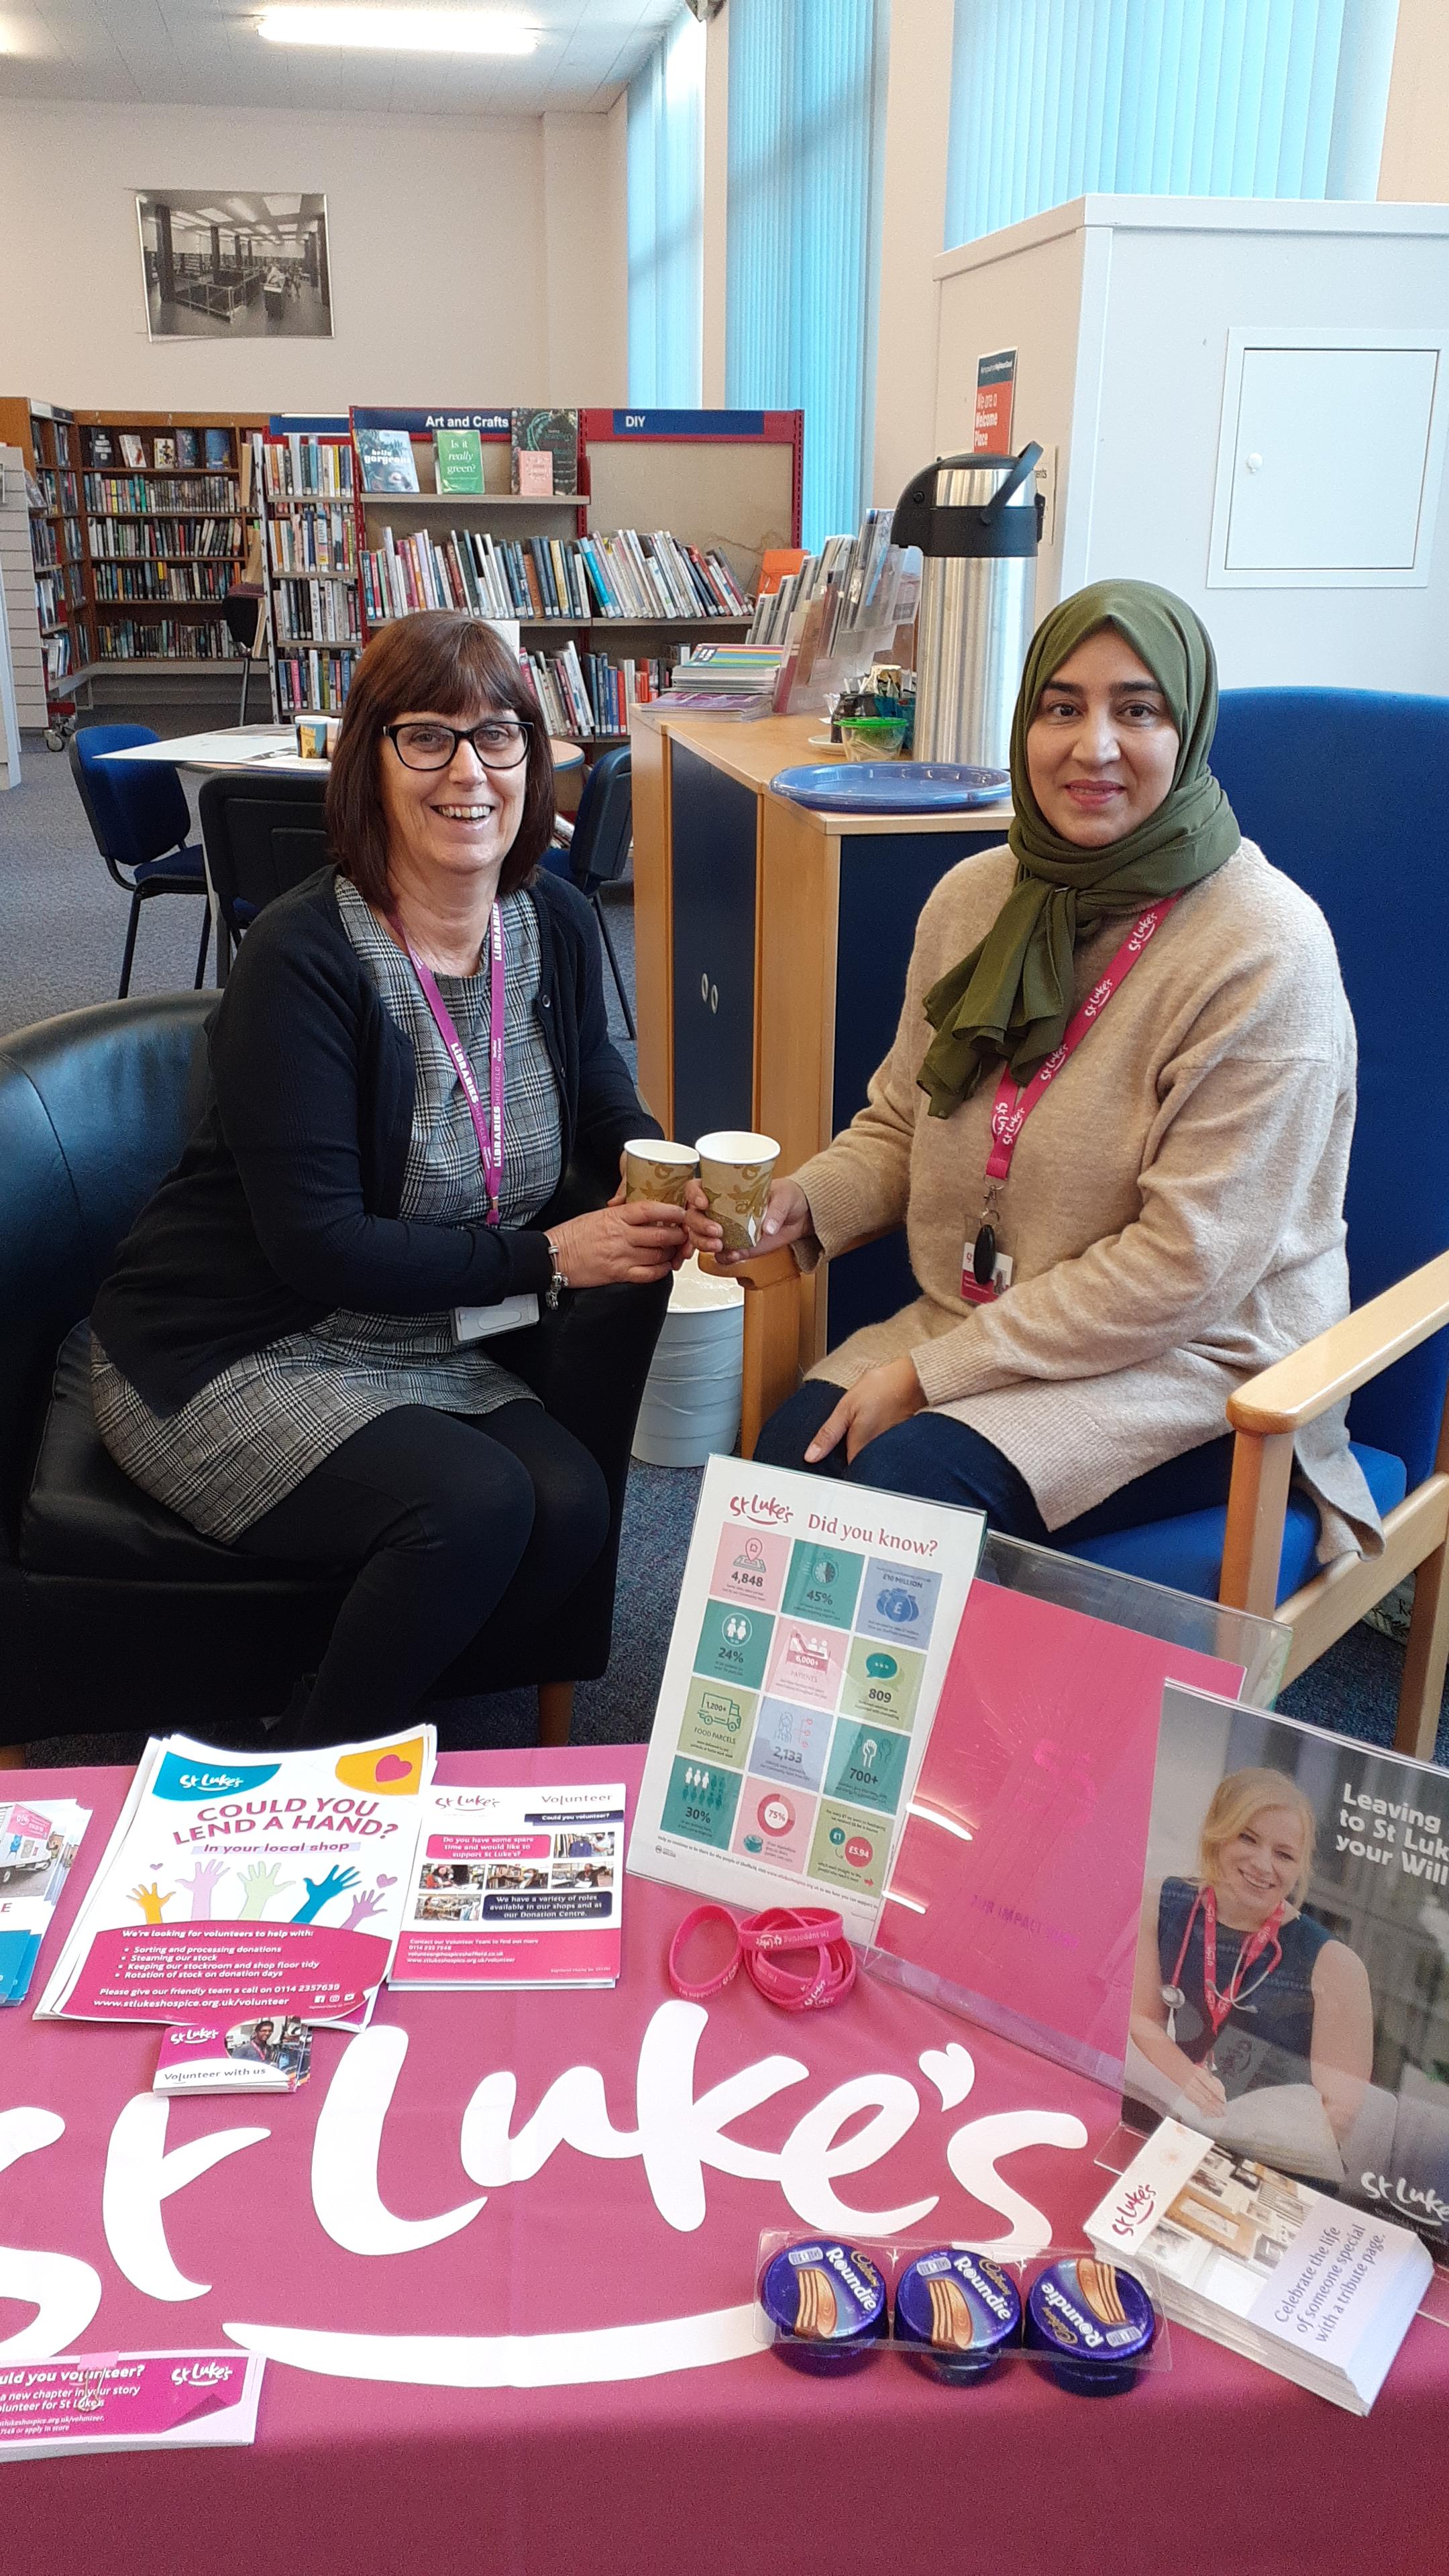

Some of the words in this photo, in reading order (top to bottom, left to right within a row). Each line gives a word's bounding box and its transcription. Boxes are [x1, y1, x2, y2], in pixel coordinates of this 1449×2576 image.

[425, 416, 444, 427] Art
[447, 416, 470, 427] and
[472, 416, 509, 427] Crafts
[625, 415, 645, 427] DIY
[976, 411, 998, 428] Welcome
[450, 440, 461, 448] Is
[462, 439, 468, 448] it
[975, 430, 988, 447] Place
[447, 451, 474, 463] really
[447, 464, 476, 475] green?
[1132, 913, 1157, 939] Luke's
[1128, 938, 1141, 951] St
[1089, 979, 1113, 1006] Luke's
[1084, 1004, 1097, 1016] St
[1045, 1044, 1069, 1069] Luke's
[1041, 1068, 1052, 1080] St
[474, 1104, 486, 1141] SHEFFIELD
[1002, 1132, 1012, 1144] St
[730, 1496, 750, 1516] St
[751, 1495, 794, 1523] Luke's
[808, 1513, 838, 1534] Did
[840, 1524, 873, 1543] you
[879, 1528, 938, 1557] know?
[731, 1571, 763, 1587] 4,848
[896, 1576, 923, 1589] MILLION
[806, 1590, 833, 1605] 45%
[718, 1648, 744, 1664] 24%
[796, 1654, 819, 1666] 6,000+
[868, 1688, 892, 1703] 809
[706, 1701, 727, 1712] 1,200+
[694, 1727, 712, 1739] FOOD
[712, 1731, 736, 1744] PARCELS
[773, 1746, 802, 1764] 2,133
[179, 1774, 199, 1788] St
[201, 1773, 244, 1788] Luke's
[849, 1768, 879, 1784] 700+
[197, 1798, 308, 1821] COULD
[316, 1798, 380, 1817] YOU
[435, 1797, 454, 1809] St
[541, 1794, 613, 1805] Volunteer
[1343, 1782, 1441, 1835] Leaving
[685, 1807, 711, 1824] 30%
[768, 1809, 786, 1822] 75%
[172, 1818, 256, 1845] LEND
[262, 1816, 284, 1830] A
[292, 1815, 399, 1839] HAND?
[1340, 1809, 1365, 1832] to
[1373, 1819, 1396, 1843] St
[833, 1832, 842, 1840] £1
[203, 1844, 221, 1852] In
[223, 1844, 260, 1854] your
[264, 1842, 305, 1852] local
[309, 1843, 350, 1854] shop
[1336, 1835, 1393, 1866] your
[1401, 1851, 1449, 1886] Will
[539, 1895, 566, 1903] variety
[151, 1930, 186, 1939] looking
[267, 1930, 288, 1939] help
[134, 1946, 167, 1955] Sorting
[186, 1946, 235, 1955] processing
[127, 1963, 164, 1971] Keeping
[253, 1962, 275, 1970] shop
[301, 1961, 320, 1969] tidy
[131, 1955, 173, 1963] Steaming
[218, 1970, 260, 1978] donation
[262, 1970, 283, 1978] days
[130, 1988, 150, 1996] give
[170, 1988, 206, 1996] friendly
[274, 1985, 297, 1993] 0114
[93, 1998, 290, 2008] www.stlukeshospice.org.uk/volunteer
[170, 2033, 185, 2045] St
[164, 2070, 221, 2082] Volunteer
[223, 2068, 250, 2076] with
[311, 2000, 1088, 2263] Luke's
[1360, 2171, 1394, 2199] St
[1116, 2184, 1156, 2218] Luke's
[1112, 2216, 1134, 2237] St
[1362, 2234, 1386, 2265] page.
[826, 2247, 877, 2312] Roundie
[1275, 2266, 1317, 2322] Celebrate
[1309, 2247, 1329, 2267] the
[1319, 2226, 1341, 2247] life
[1296, 2314, 1313, 2333] of
[1305, 2264, 1343, 2318] someone
[1337, 2224, 1366, 2265] special
[953, 2255, 1011, 2320] Roundie
[1337, 2263, 1368, 2304] tribute
[1041, 2282, 1104, 2348] Roundie
[1332, 2304, 1344, 2314] a
[1316, 2314, 1339, 2343] with
[25, 2371, 57, 2387] you
[60, 2365, 146, 2382] volunteer?
[170, 2368, 191, 2385] St
[9, 2392, 32, 2401] new
[33, 2388, 73, 2400] chapter
[113, 2385, 141, 2396] story
[42, 2401, 58, 2410] for
[59, 2400, 71, 2409] St
